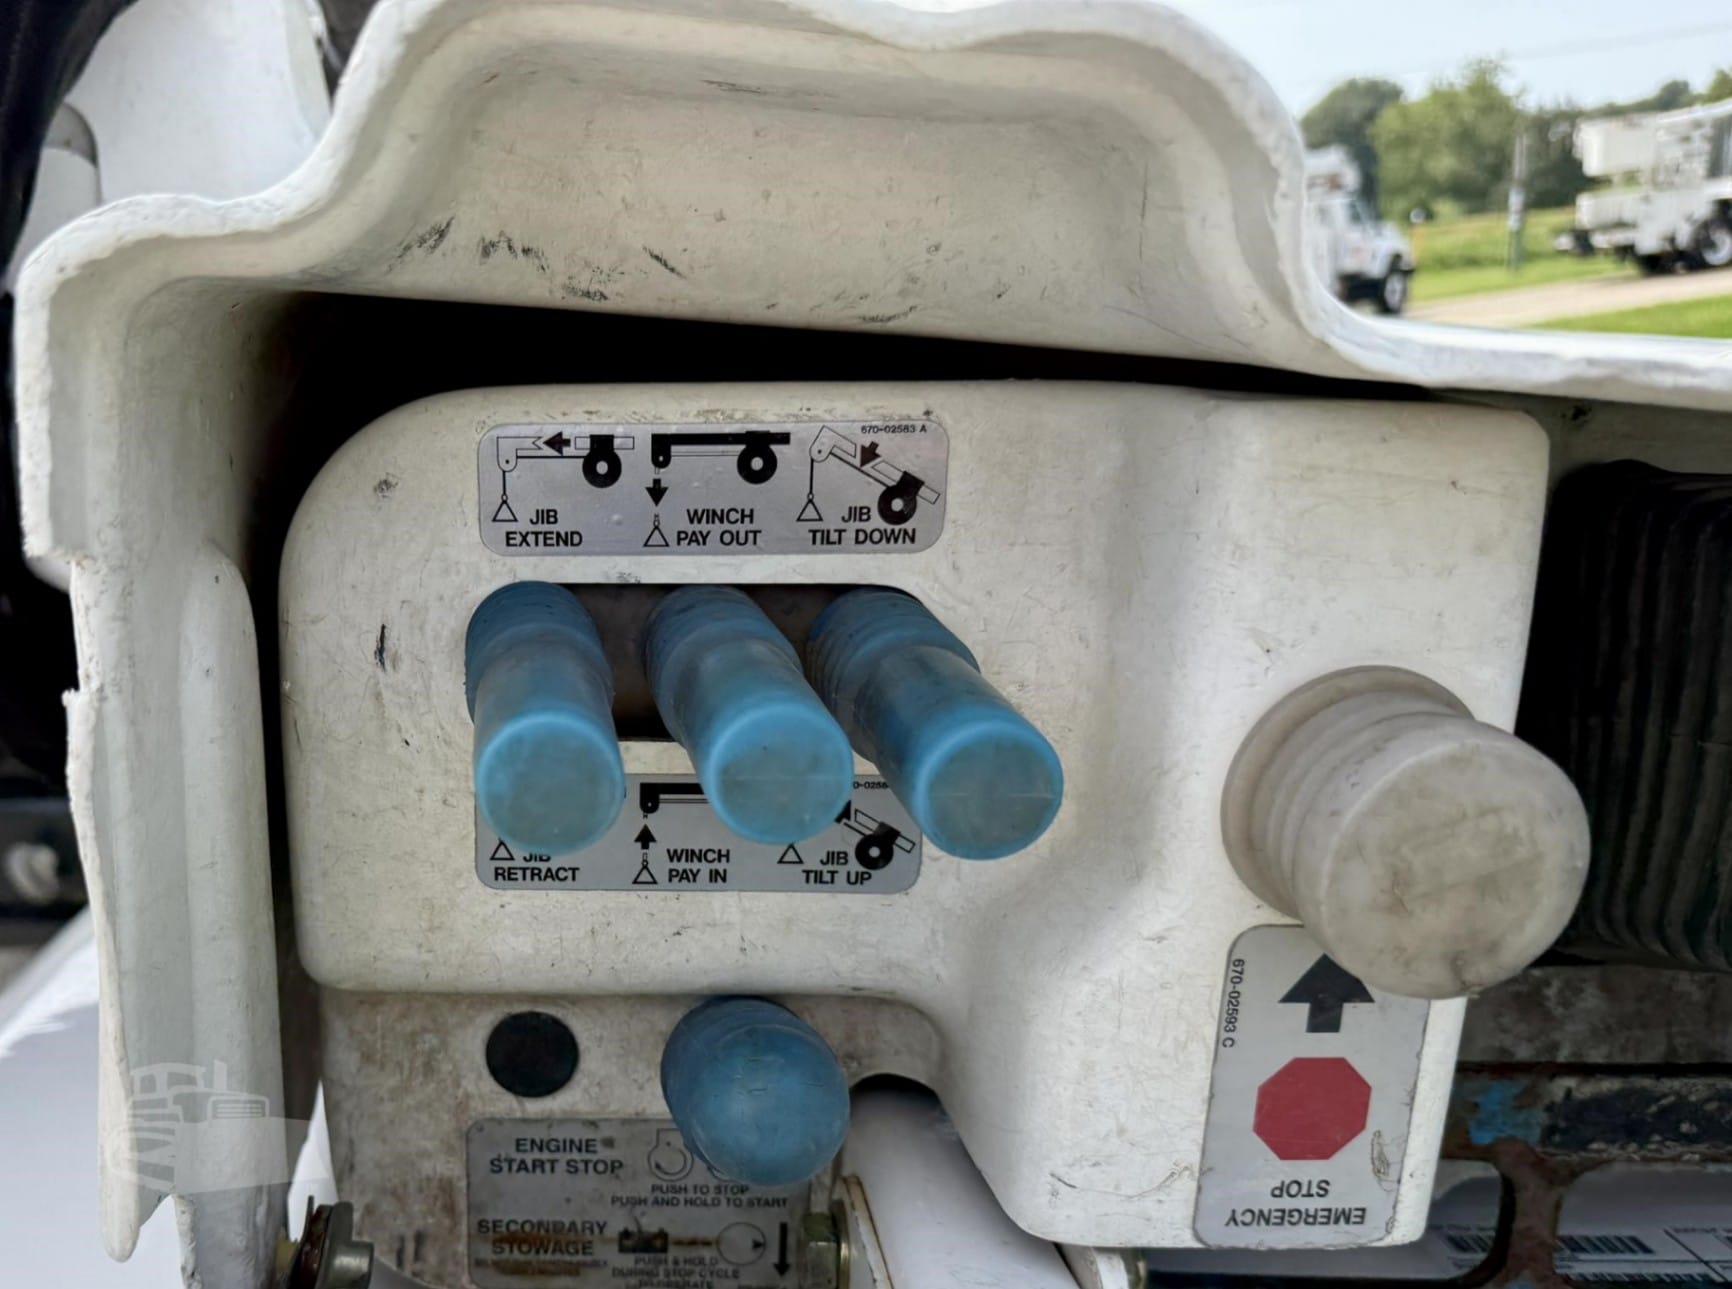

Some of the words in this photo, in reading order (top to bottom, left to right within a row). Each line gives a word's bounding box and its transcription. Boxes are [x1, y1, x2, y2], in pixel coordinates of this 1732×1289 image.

[919, 423, 928, 433] A
[529, 508, 559, 525] JIB
[686, 508, 755, 525] WINCH
[841, 506, 872, 523] JIB
[505, 531, 583, 547] EXTEND
[676, 530, 714, 547] PAY
[718, 529, 762, 546] OUT
[808, 529, 850, 546] TILT
[854, 528, 917, 545] DOWN
[667, 848, 731, 864] WINCH
[819, 850, 849, 866] JIB
[494, 866, 580, 882] RETRACT
[667, 868, 700, 884] PAY
[708, 868, 728, 884] IN
[802, 870, 838, 885] TILT
[847, 870, 873, 886] UP
[1222, 958, 1246, 1034] 670-02593
[1222, 1037, 1236, 1049] C
[514, 1138, 598, 1154] ENGINE
[489, 1158, 562, 1175] START
[566, 1159, 624, 1176] STOP
[651, 1184, 687, 1195] PUSH
[692, 1184, 710, 1195] TO
[714, 1184, 750, 1196] STOP
[1270, 1179, 1332, 1199] STOP
[611, 1196, 648, 1207] PUSH
[651, 1196, 680, 1207] AND
[684, 1196, 721, 1208] HOLD
[725, 1197, 742, 1208] TO
[745, 1198, 789, 1208] START
[1224, 1207, 1367, 1227] EMERGENCY
[477, 1219, 608, 1236] SECONDARY
[492, 1239, 595, 1257] STOWAGE
[664, 1267, 695, 1278] STOP
[698, 1268, 740, 1279] CYCLE
